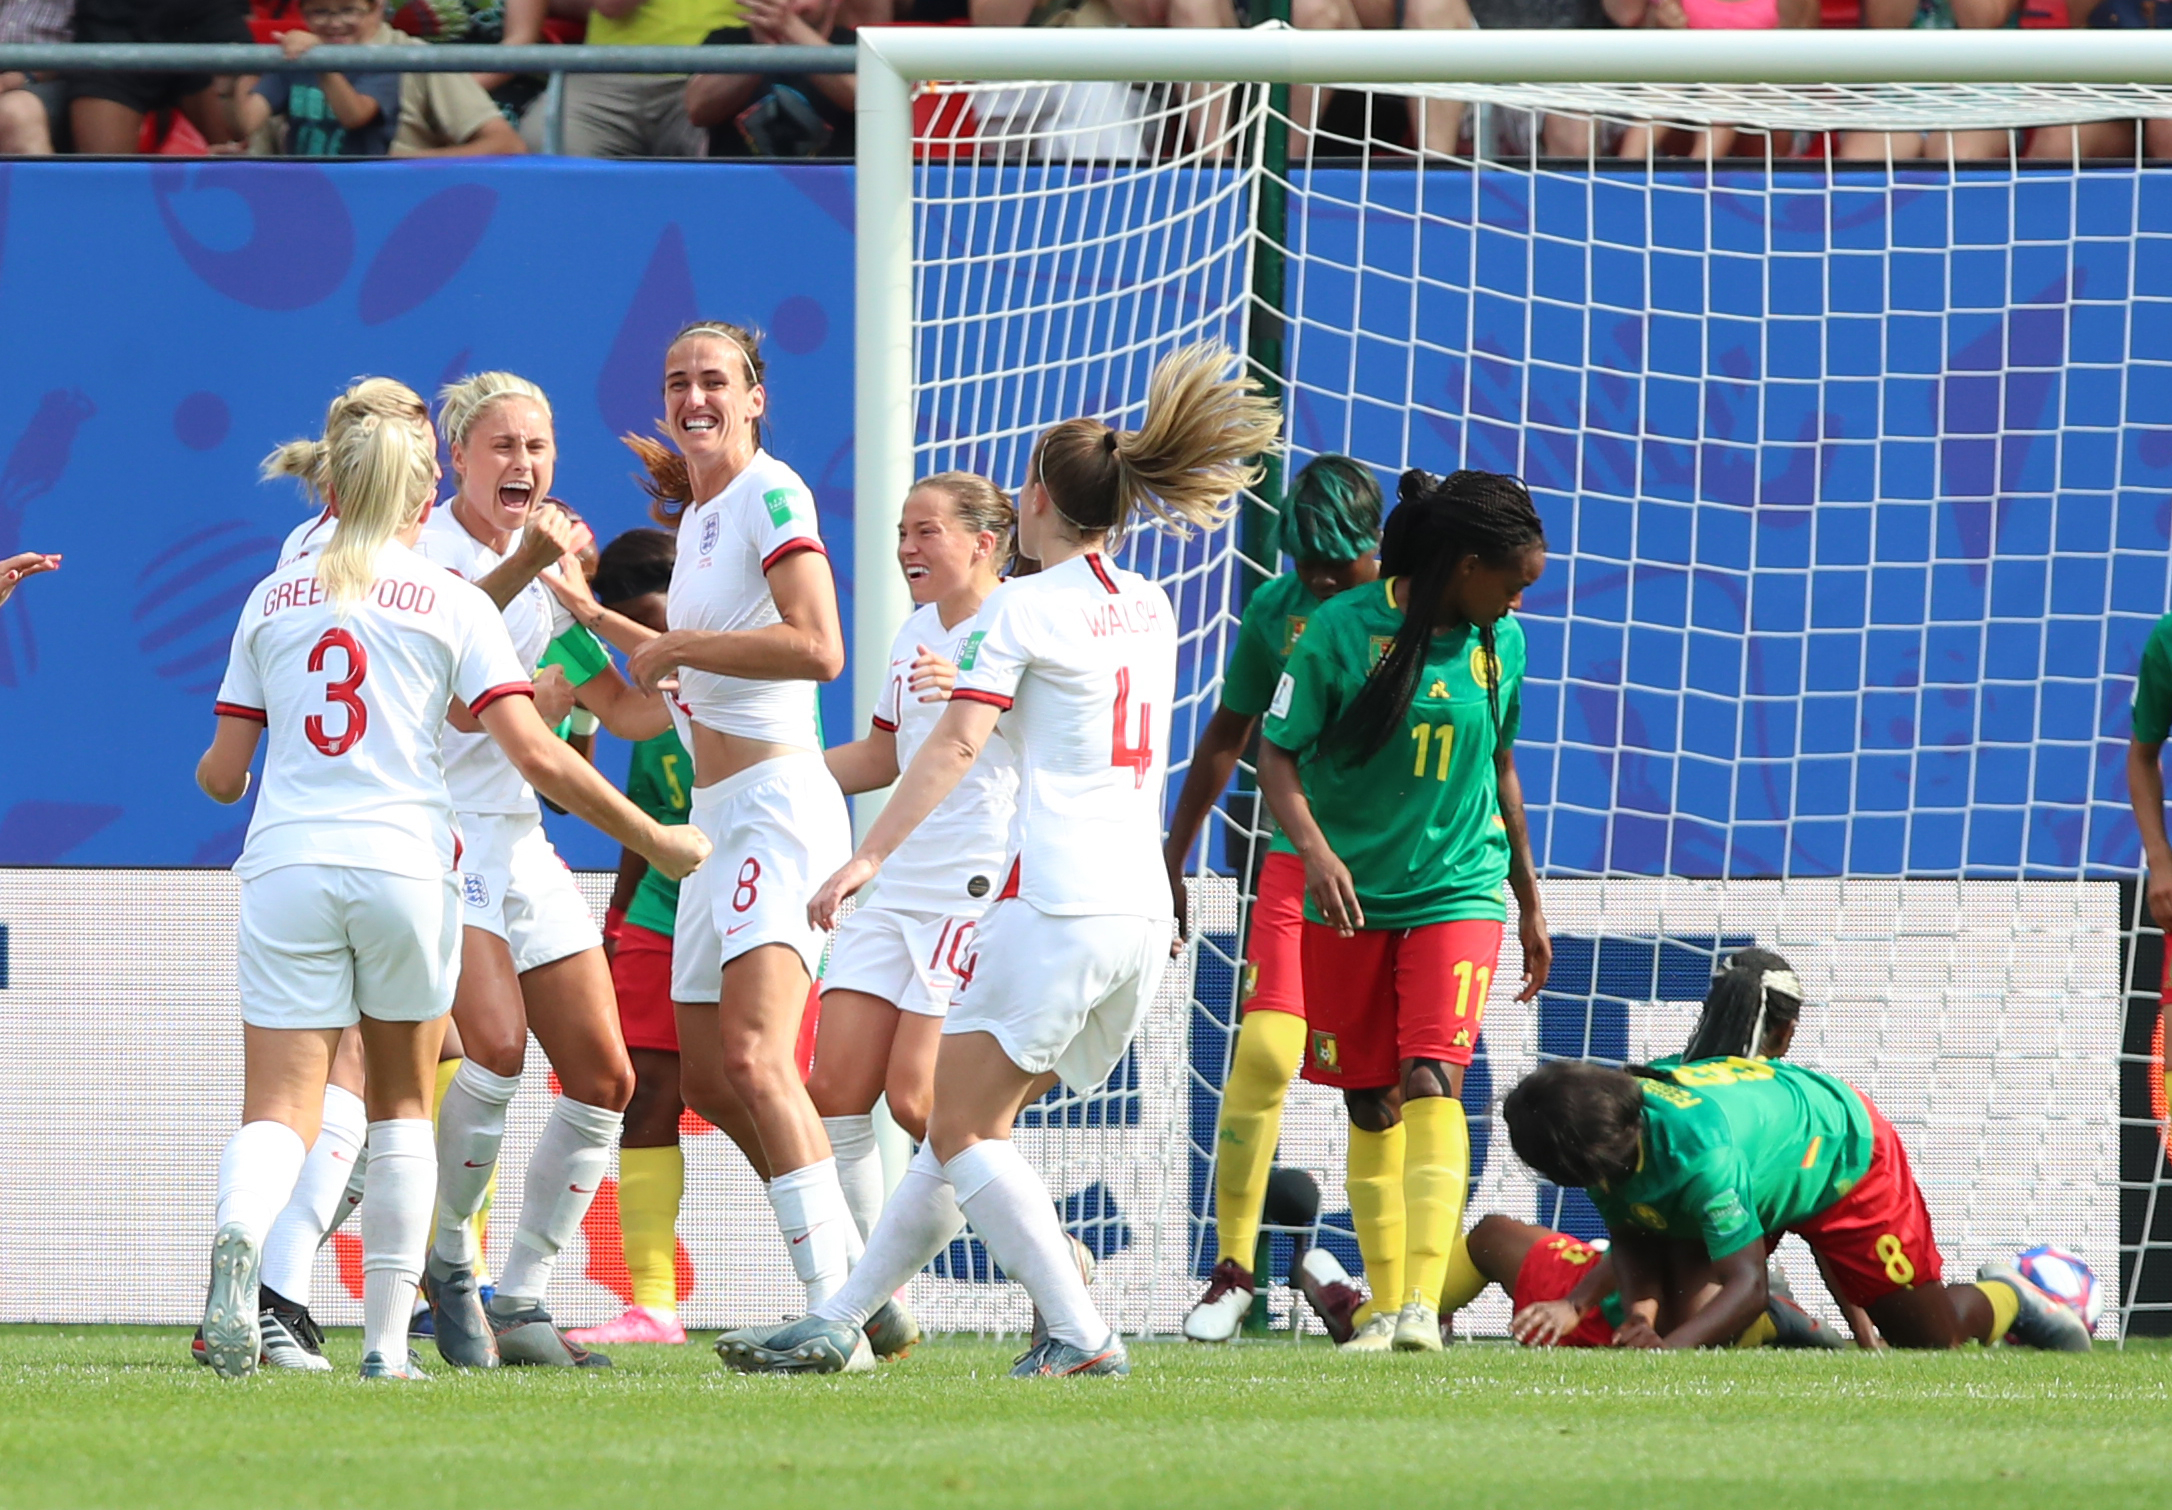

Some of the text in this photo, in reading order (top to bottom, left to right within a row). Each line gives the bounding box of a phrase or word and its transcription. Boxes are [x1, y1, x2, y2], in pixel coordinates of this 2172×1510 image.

[1080, 600, 1161, 637] WALSH
[305, 627, 368, 757] 3
[1111, 666, 1153, 790] 4
[1412, 723, 1454, 781] 11
[662, 754, 686, 810] 5
[733, 857, 761, 912] 8
[1453, 960, 1490, 1022] 11
[1875, 1233, 1914, 1285] 8
